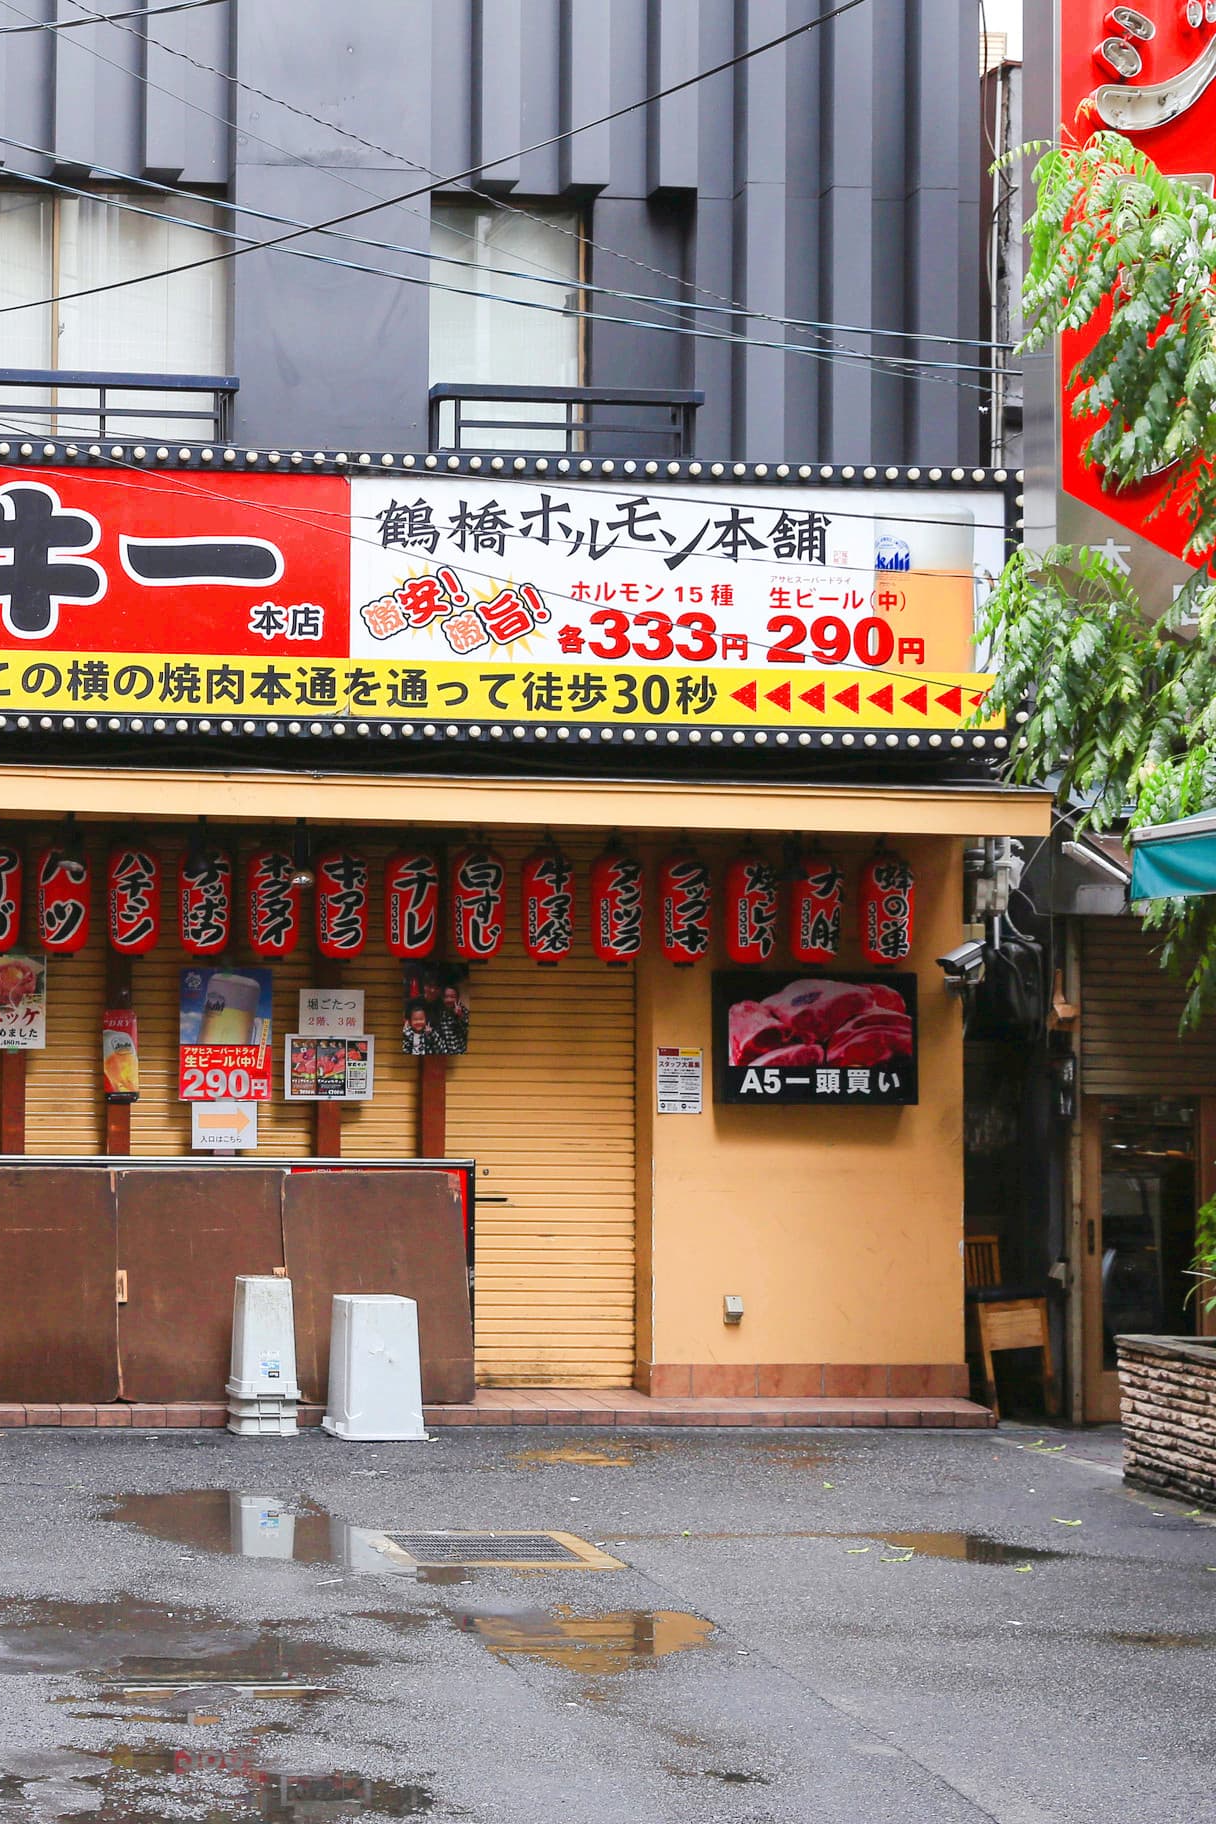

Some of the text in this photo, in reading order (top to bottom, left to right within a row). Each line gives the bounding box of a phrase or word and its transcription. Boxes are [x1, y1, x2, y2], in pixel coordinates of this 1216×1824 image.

[375, 492, 833, 571] 鶴橋ホルモン本舗
[769, 575, 852, 585] アサヒスーパードライ
[251, 604, 323, 638] 本店
[557, 609, 748, 662] 各333円
[766, 614, 925, 666] 290円
[392, 856, 439, 950] チレ
[457, 851, 505, 954] 白すじ
[738, 898, 749, 947] 333円
[184, 1047, 256, 1055] アサヒスーパードライ
[182, 1068, 268, 1099] 290円
[739, 1066, 901, 1096] A5一頭買い
[200, 1135, 242, 1144] 入口はこちら
